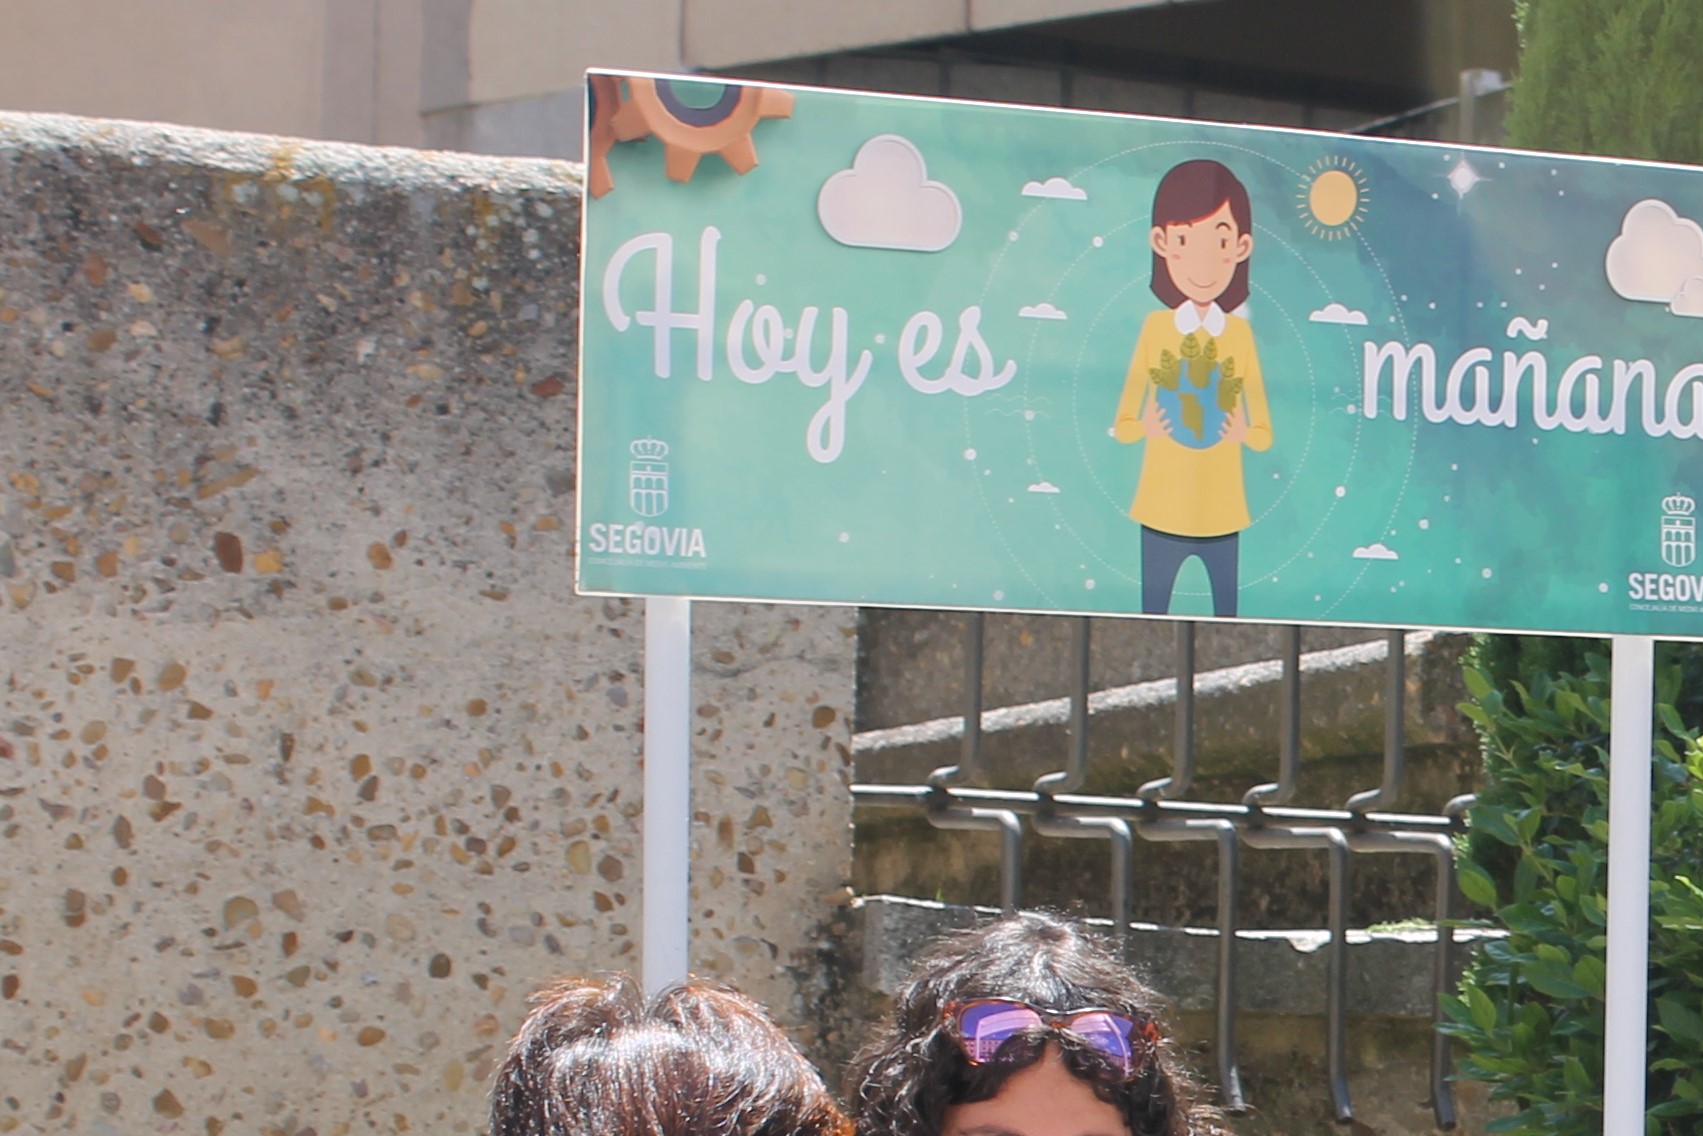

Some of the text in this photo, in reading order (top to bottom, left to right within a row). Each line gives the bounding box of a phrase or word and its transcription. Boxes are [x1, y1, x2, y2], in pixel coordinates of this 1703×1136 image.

[603, 226, 1017, 463] Hoy es
[588, 522, 707, 557] SEGOVIA
